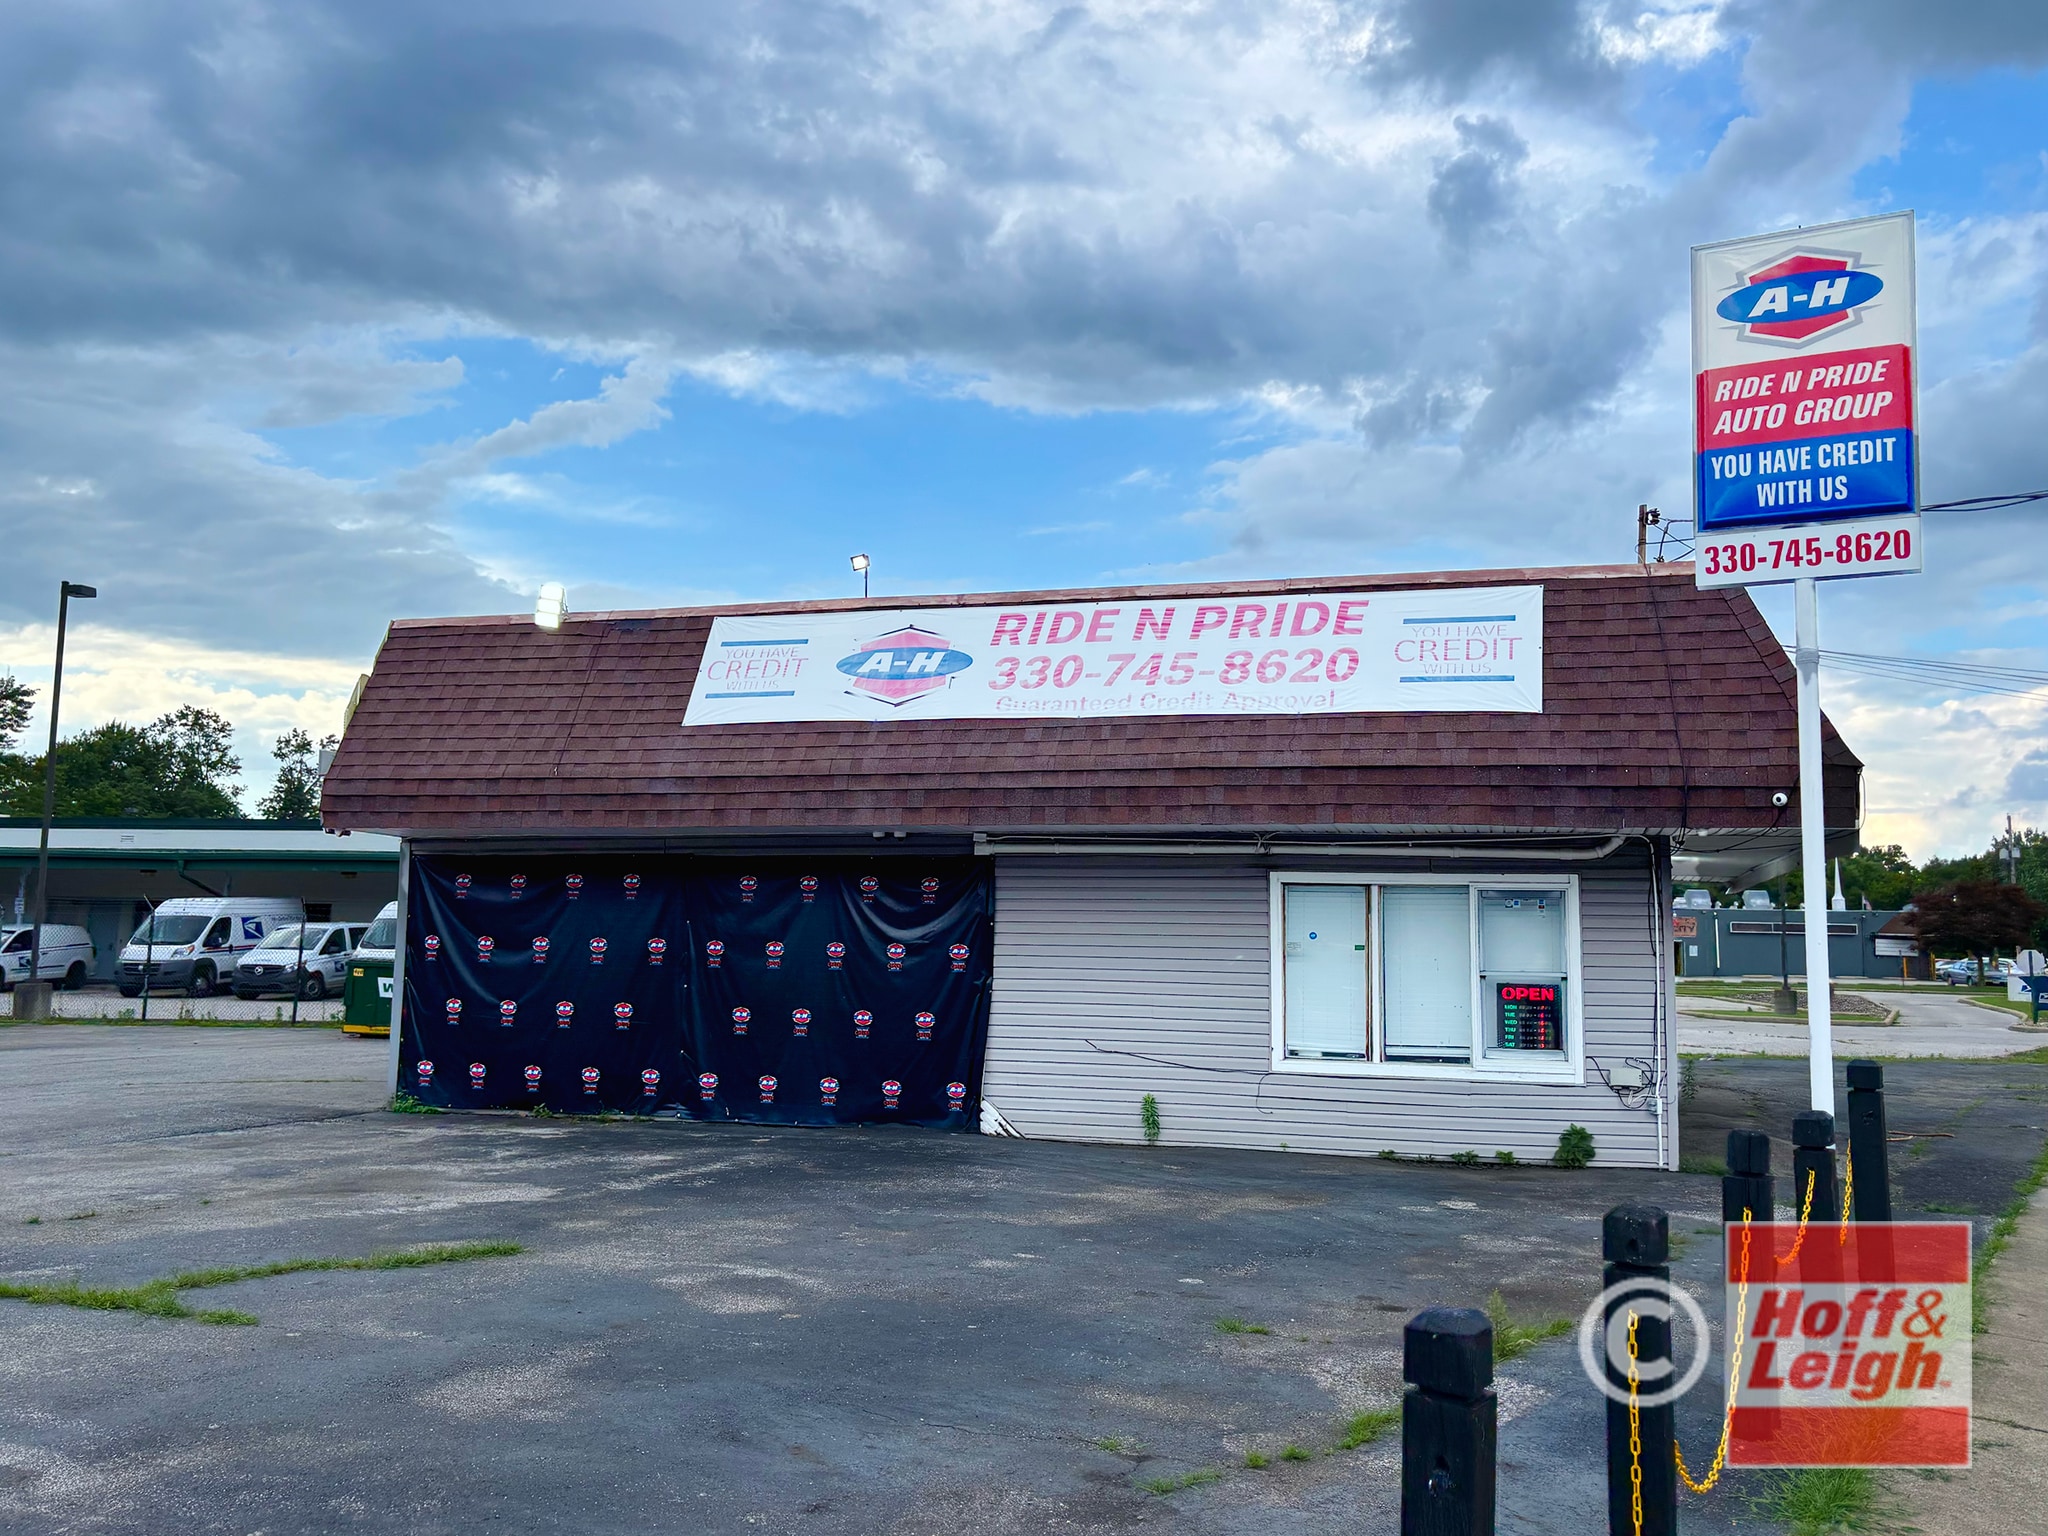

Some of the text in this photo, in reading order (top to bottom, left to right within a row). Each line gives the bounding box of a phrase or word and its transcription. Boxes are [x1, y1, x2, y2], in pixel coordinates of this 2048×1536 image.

[1748, 276, 1850, 318] A-H
[1714, 359, 1890, 402] RIDE N PRIDE
[1713, 391, 1893, 435] AUTO GROUP
[1712, 437, 1896, 480] YOU HAVE CREDIT
[1757, 475, 1848, 508] WITH US
[1704, 529, 1911, 575] 330-745-8620
[990, 600, 1370, 647] RIDE N PRIDE
[1412, 624, 1508, 638] YOU HAVE
[726, 647, 799, 660] YOU HAVE
[856, 651, 946, 673] A-H
[1394, 637, 1523, 662] CREDIT
[707, 658, 809, 680] CREDIT
[988, 647, 1360, 690] 330-745-8620
[1423, 663, 1492, 674] WITH US
[1501, 987, 1555, 1001] OPEN
